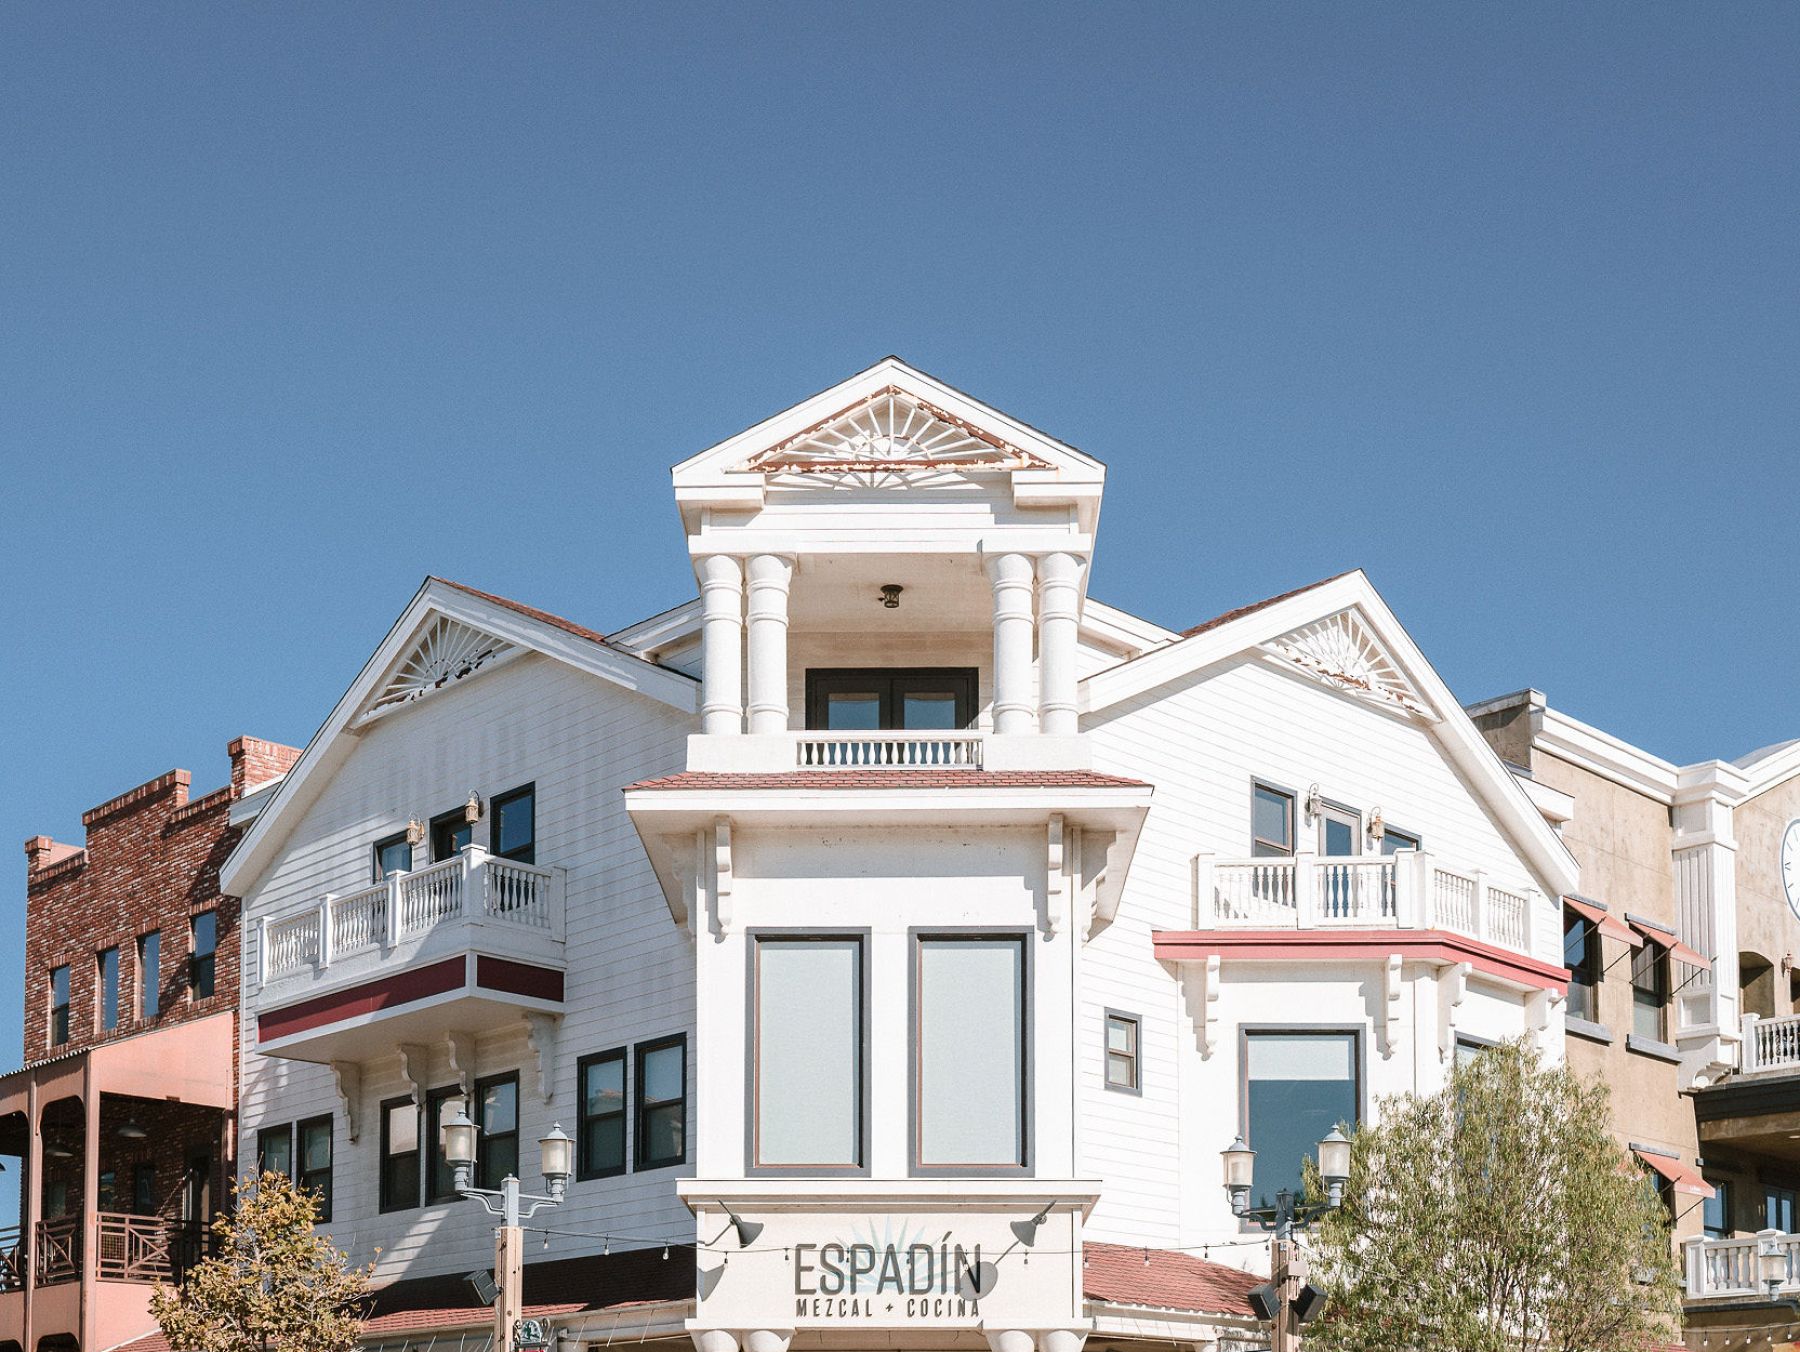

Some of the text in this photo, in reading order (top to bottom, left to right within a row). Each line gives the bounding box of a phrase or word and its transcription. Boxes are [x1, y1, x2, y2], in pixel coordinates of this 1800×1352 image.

[795, 1231, 981, 1295] ESPADÍN
[796, 1298, 873, 1317] MEZCAL
[907, 1298, 980, 1317] COCINA
